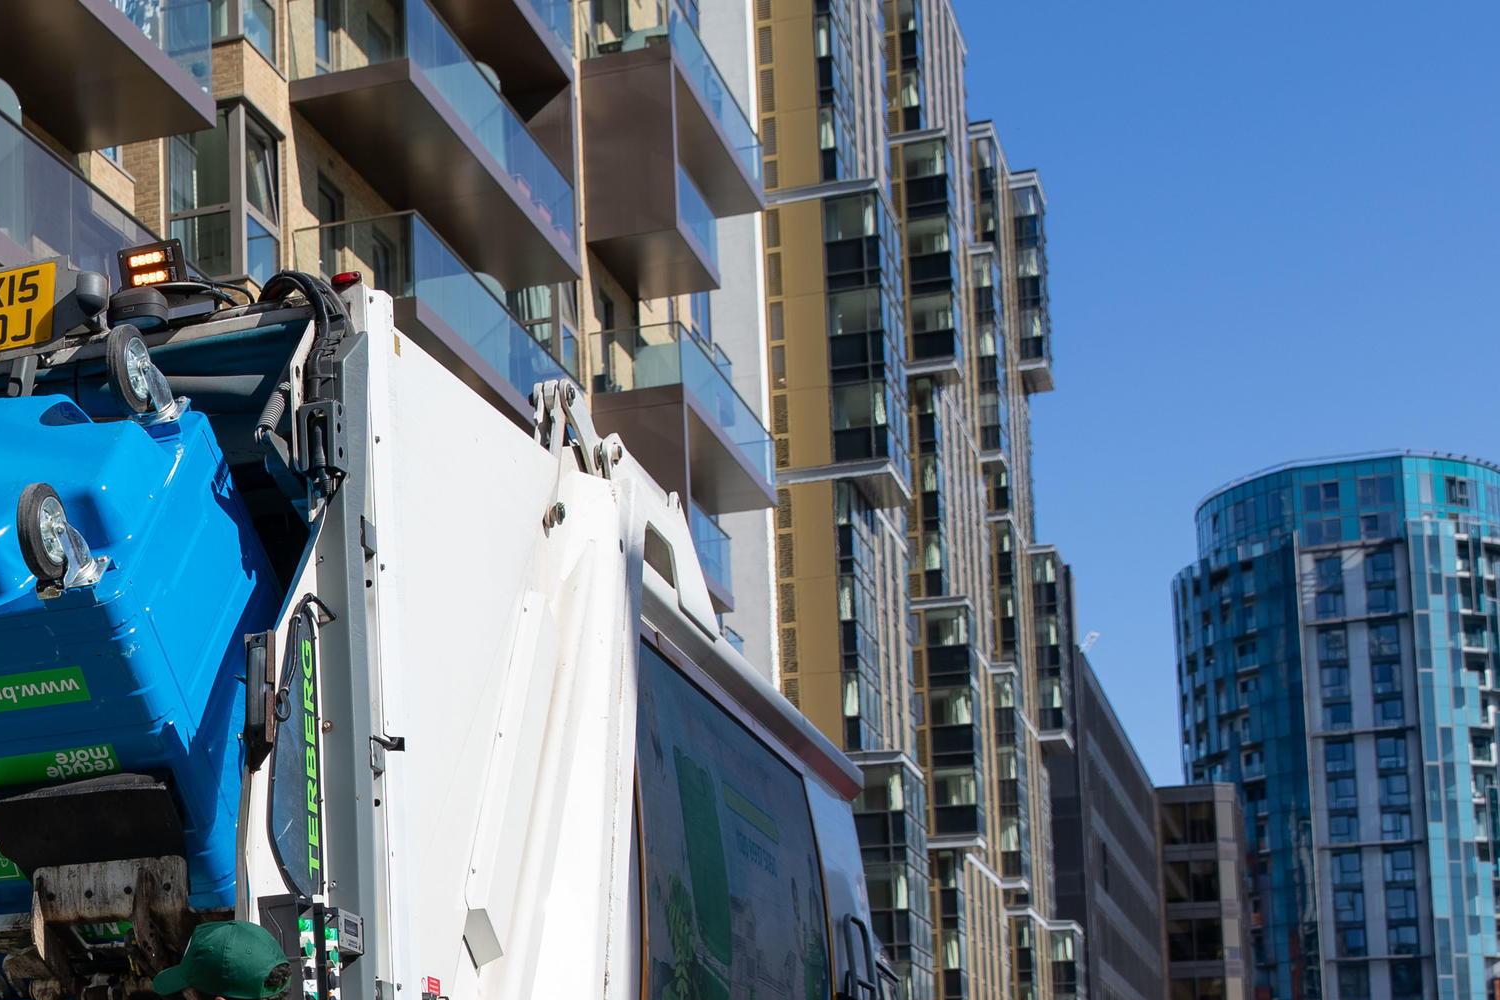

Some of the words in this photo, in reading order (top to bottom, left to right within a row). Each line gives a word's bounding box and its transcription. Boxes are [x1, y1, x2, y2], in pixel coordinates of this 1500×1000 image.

[55, 745, 109, 765] more
[300, 639, 320, 880] TERBERG
[46, 758, 115, 780] recycle
